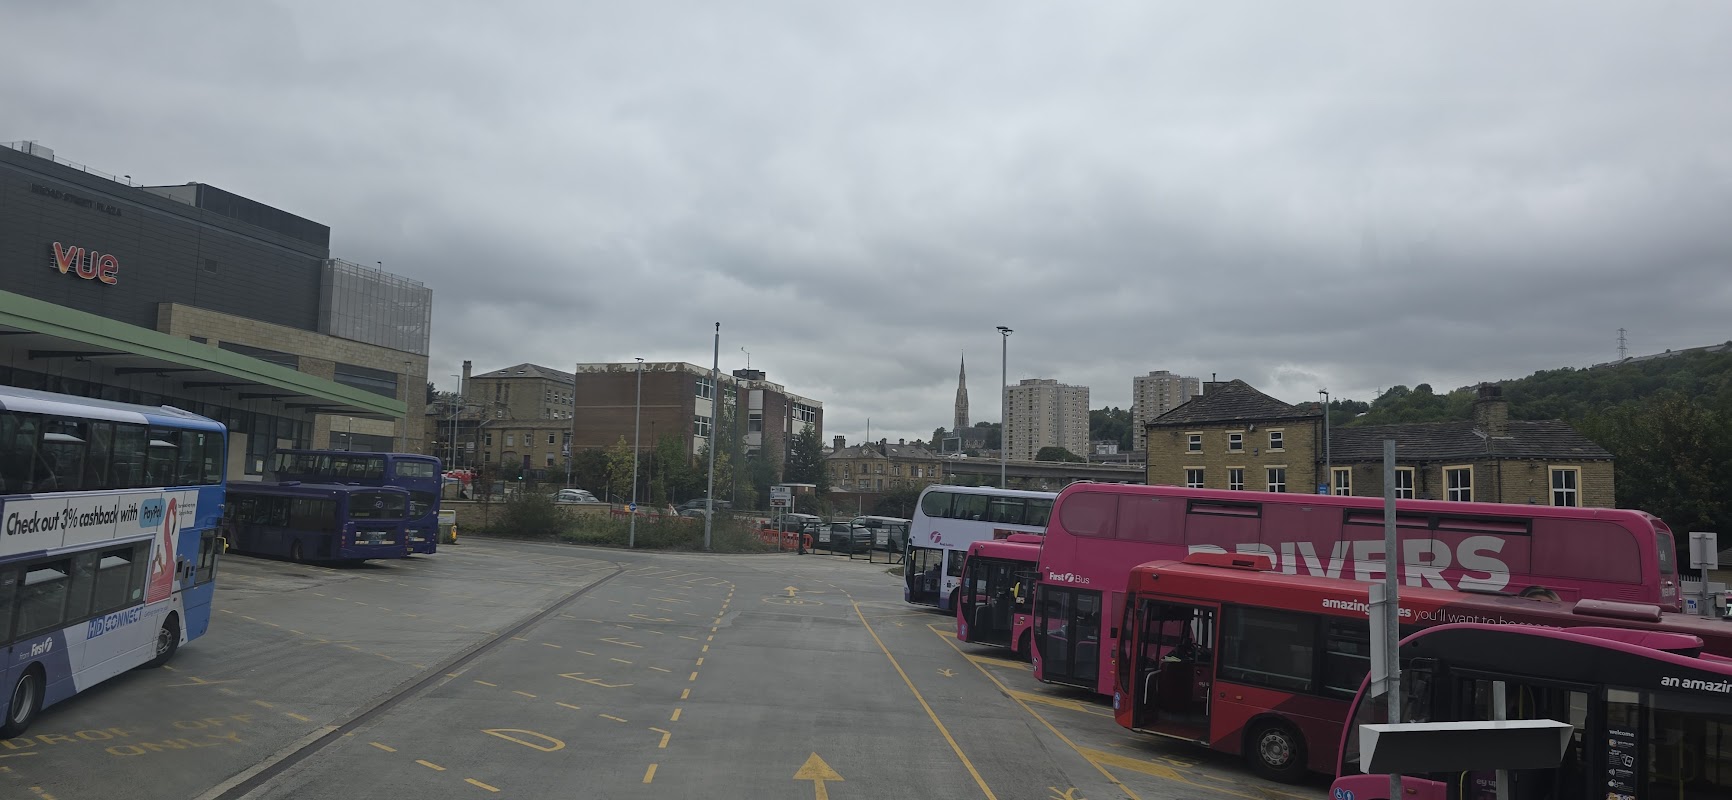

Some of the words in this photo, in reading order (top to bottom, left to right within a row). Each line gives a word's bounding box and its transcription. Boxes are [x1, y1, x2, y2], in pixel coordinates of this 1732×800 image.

[7, 510, 42, 536] Check
[42, 512, 59, 532] out
[61, 507, 78, 530] 3%
[80, 504, 119, 528] cashback
[120, 502, 138, 523] with
[143, 505, 163, 523] PayPal
[1188, 535, 1510, 592] IVERS
[1049, 571, 1065, 582] First
[1075, 574, 1090, 585] Bus
[105, 607, 144, 632] CONNECT
[1322, 597, 1370, 615] amazing
[1447, 613, 1480, 624] want
[1482, 616, 1496, 625] to
[31, 642, 45, 657] First
[1661, 676, 1680, 687] an
[174, 713, 254, 730] OFF
[1609, 729, 1635, 738] welcome
[105, 731, 243, 757] ONLY
[480, 726, 567, 752] D
